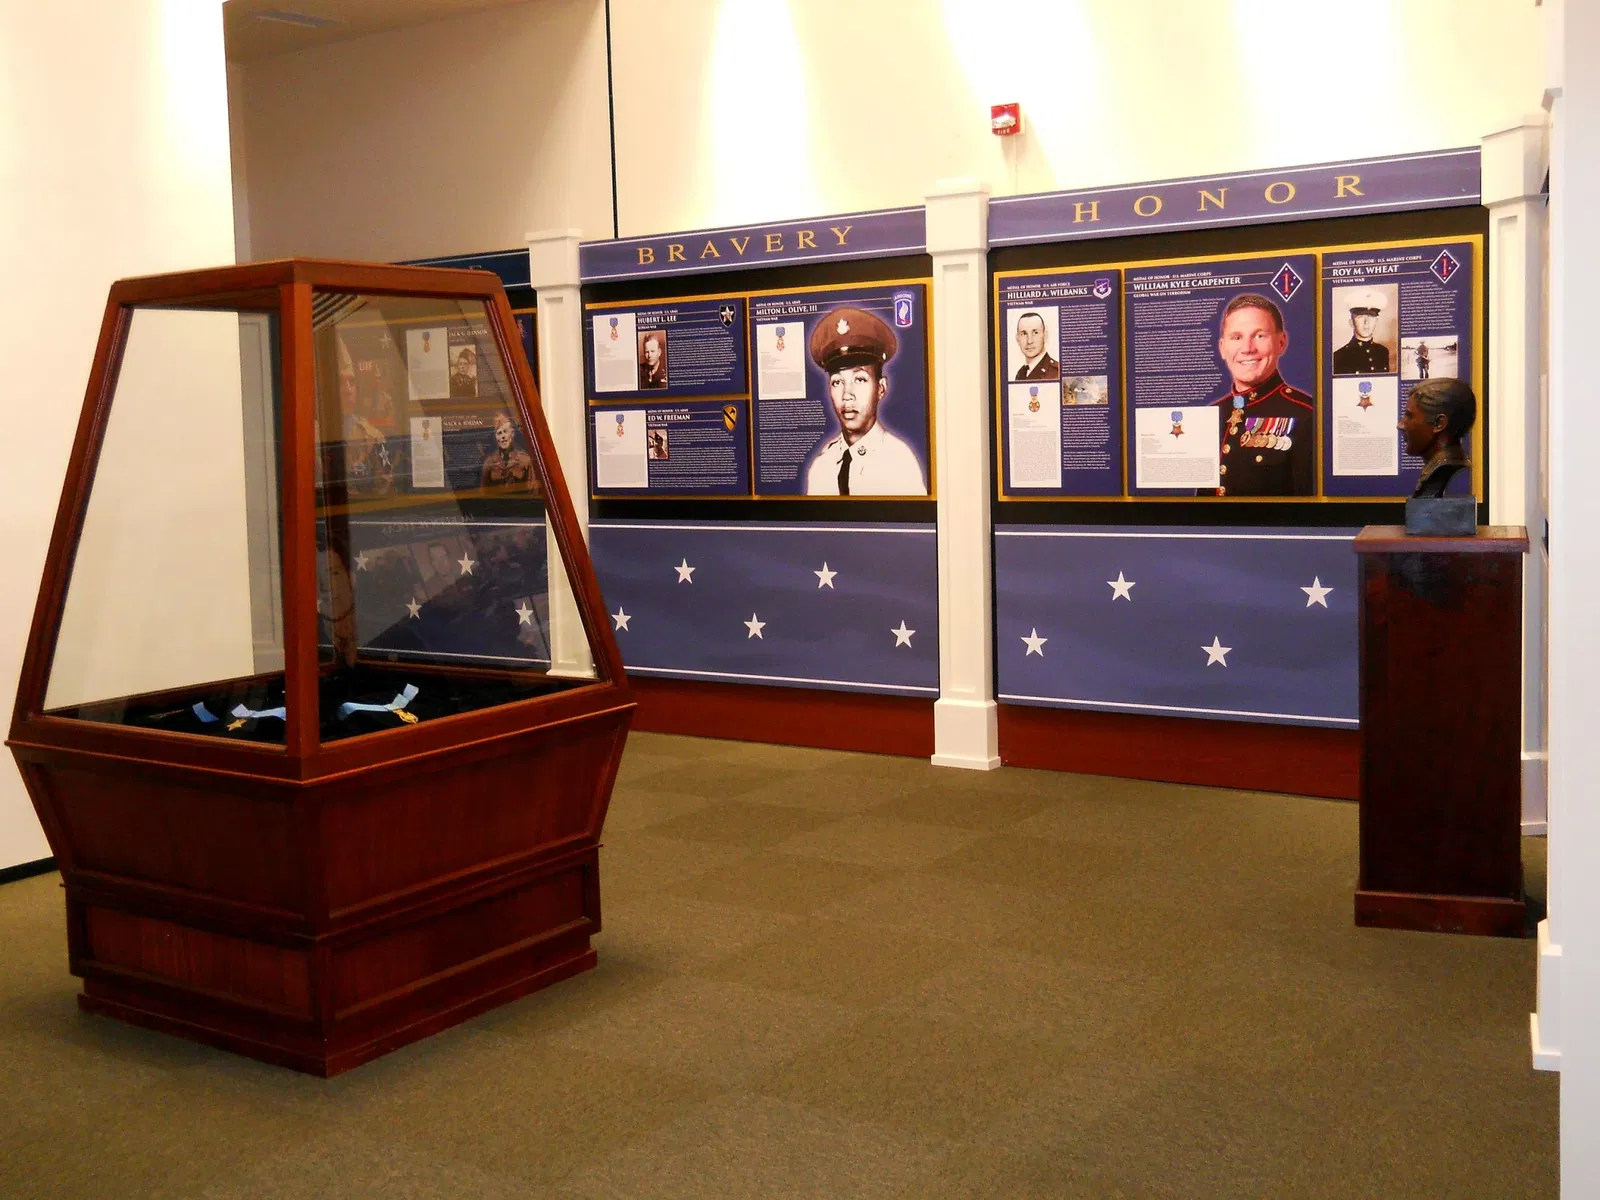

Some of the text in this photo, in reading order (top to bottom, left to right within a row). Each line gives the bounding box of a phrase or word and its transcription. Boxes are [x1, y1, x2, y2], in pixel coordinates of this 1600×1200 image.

[1071, 174, 1365, 224] HONOR
[637, 225, 852, 266] BRAVERY
[1332, 268, 1353, 276] ROY
[1366, 265, 1400, 274] WHEAT
[1133, 277, 1241, 291] WILLIAM KYLE CARPENTER
[1050, 288, 1088, 296] WILBANKS
[756, 308, 781, 316] MILTON
[637, 316, 660, 324] HUBERT
